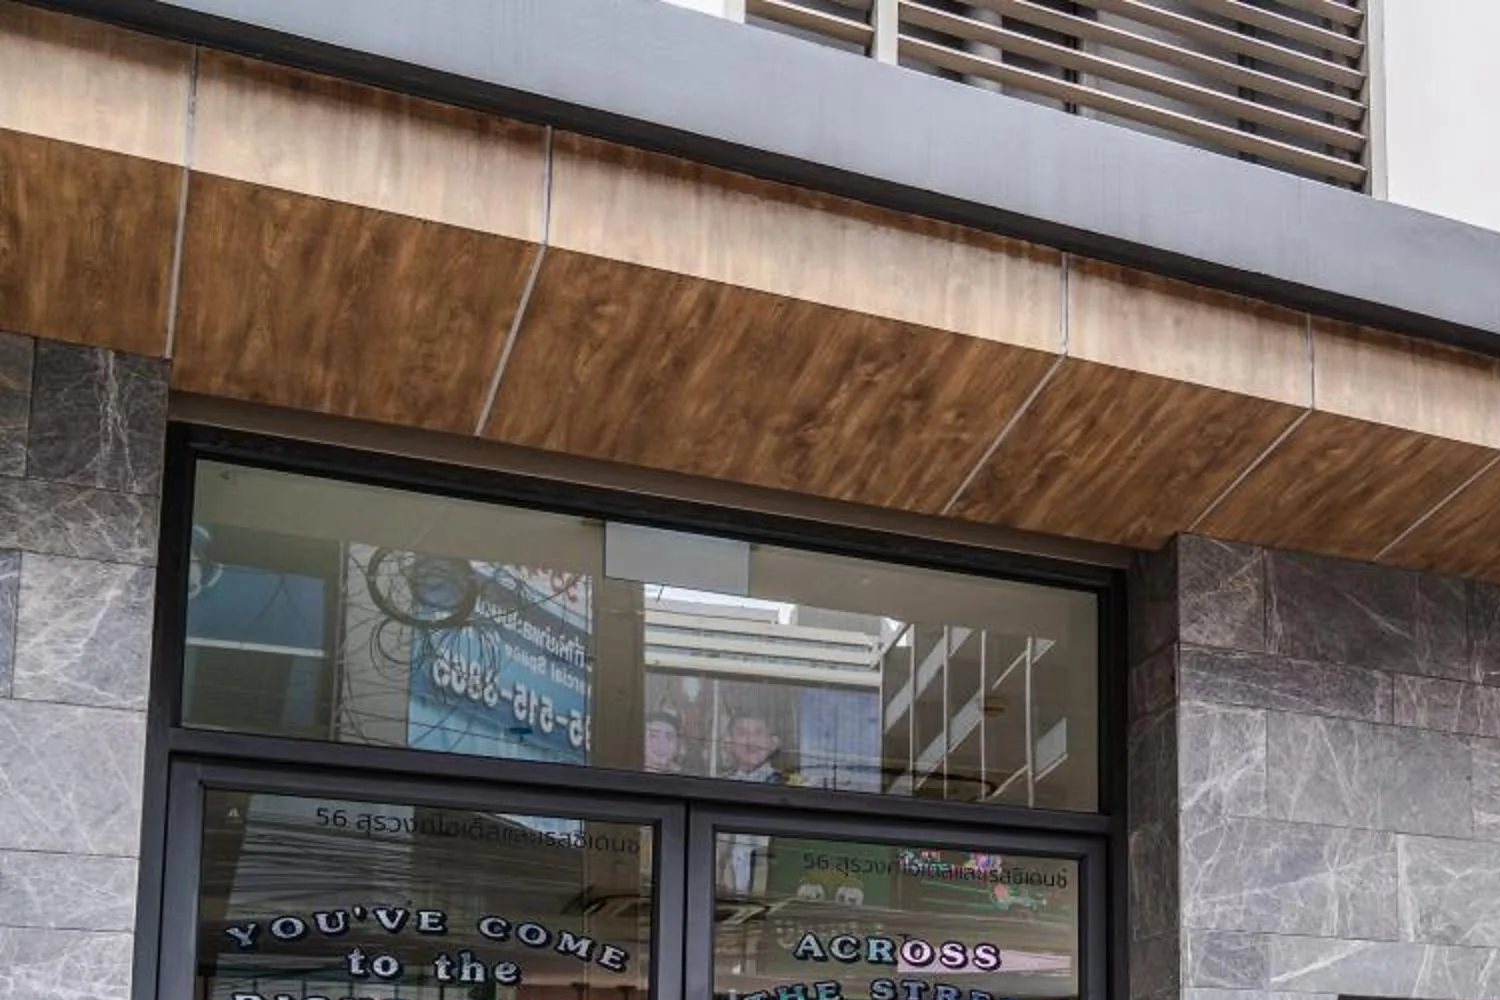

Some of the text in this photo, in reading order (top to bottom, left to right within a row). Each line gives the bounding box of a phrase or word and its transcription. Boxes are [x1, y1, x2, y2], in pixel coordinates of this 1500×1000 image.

[316, 807, 347, 828] 56
[803, 852, 829, 869] 56
[226, 907, 630, 972] YOU'VE COME
[794, 932, 1001, 971] ACROSS
[348, 948, 523, 985] to the
